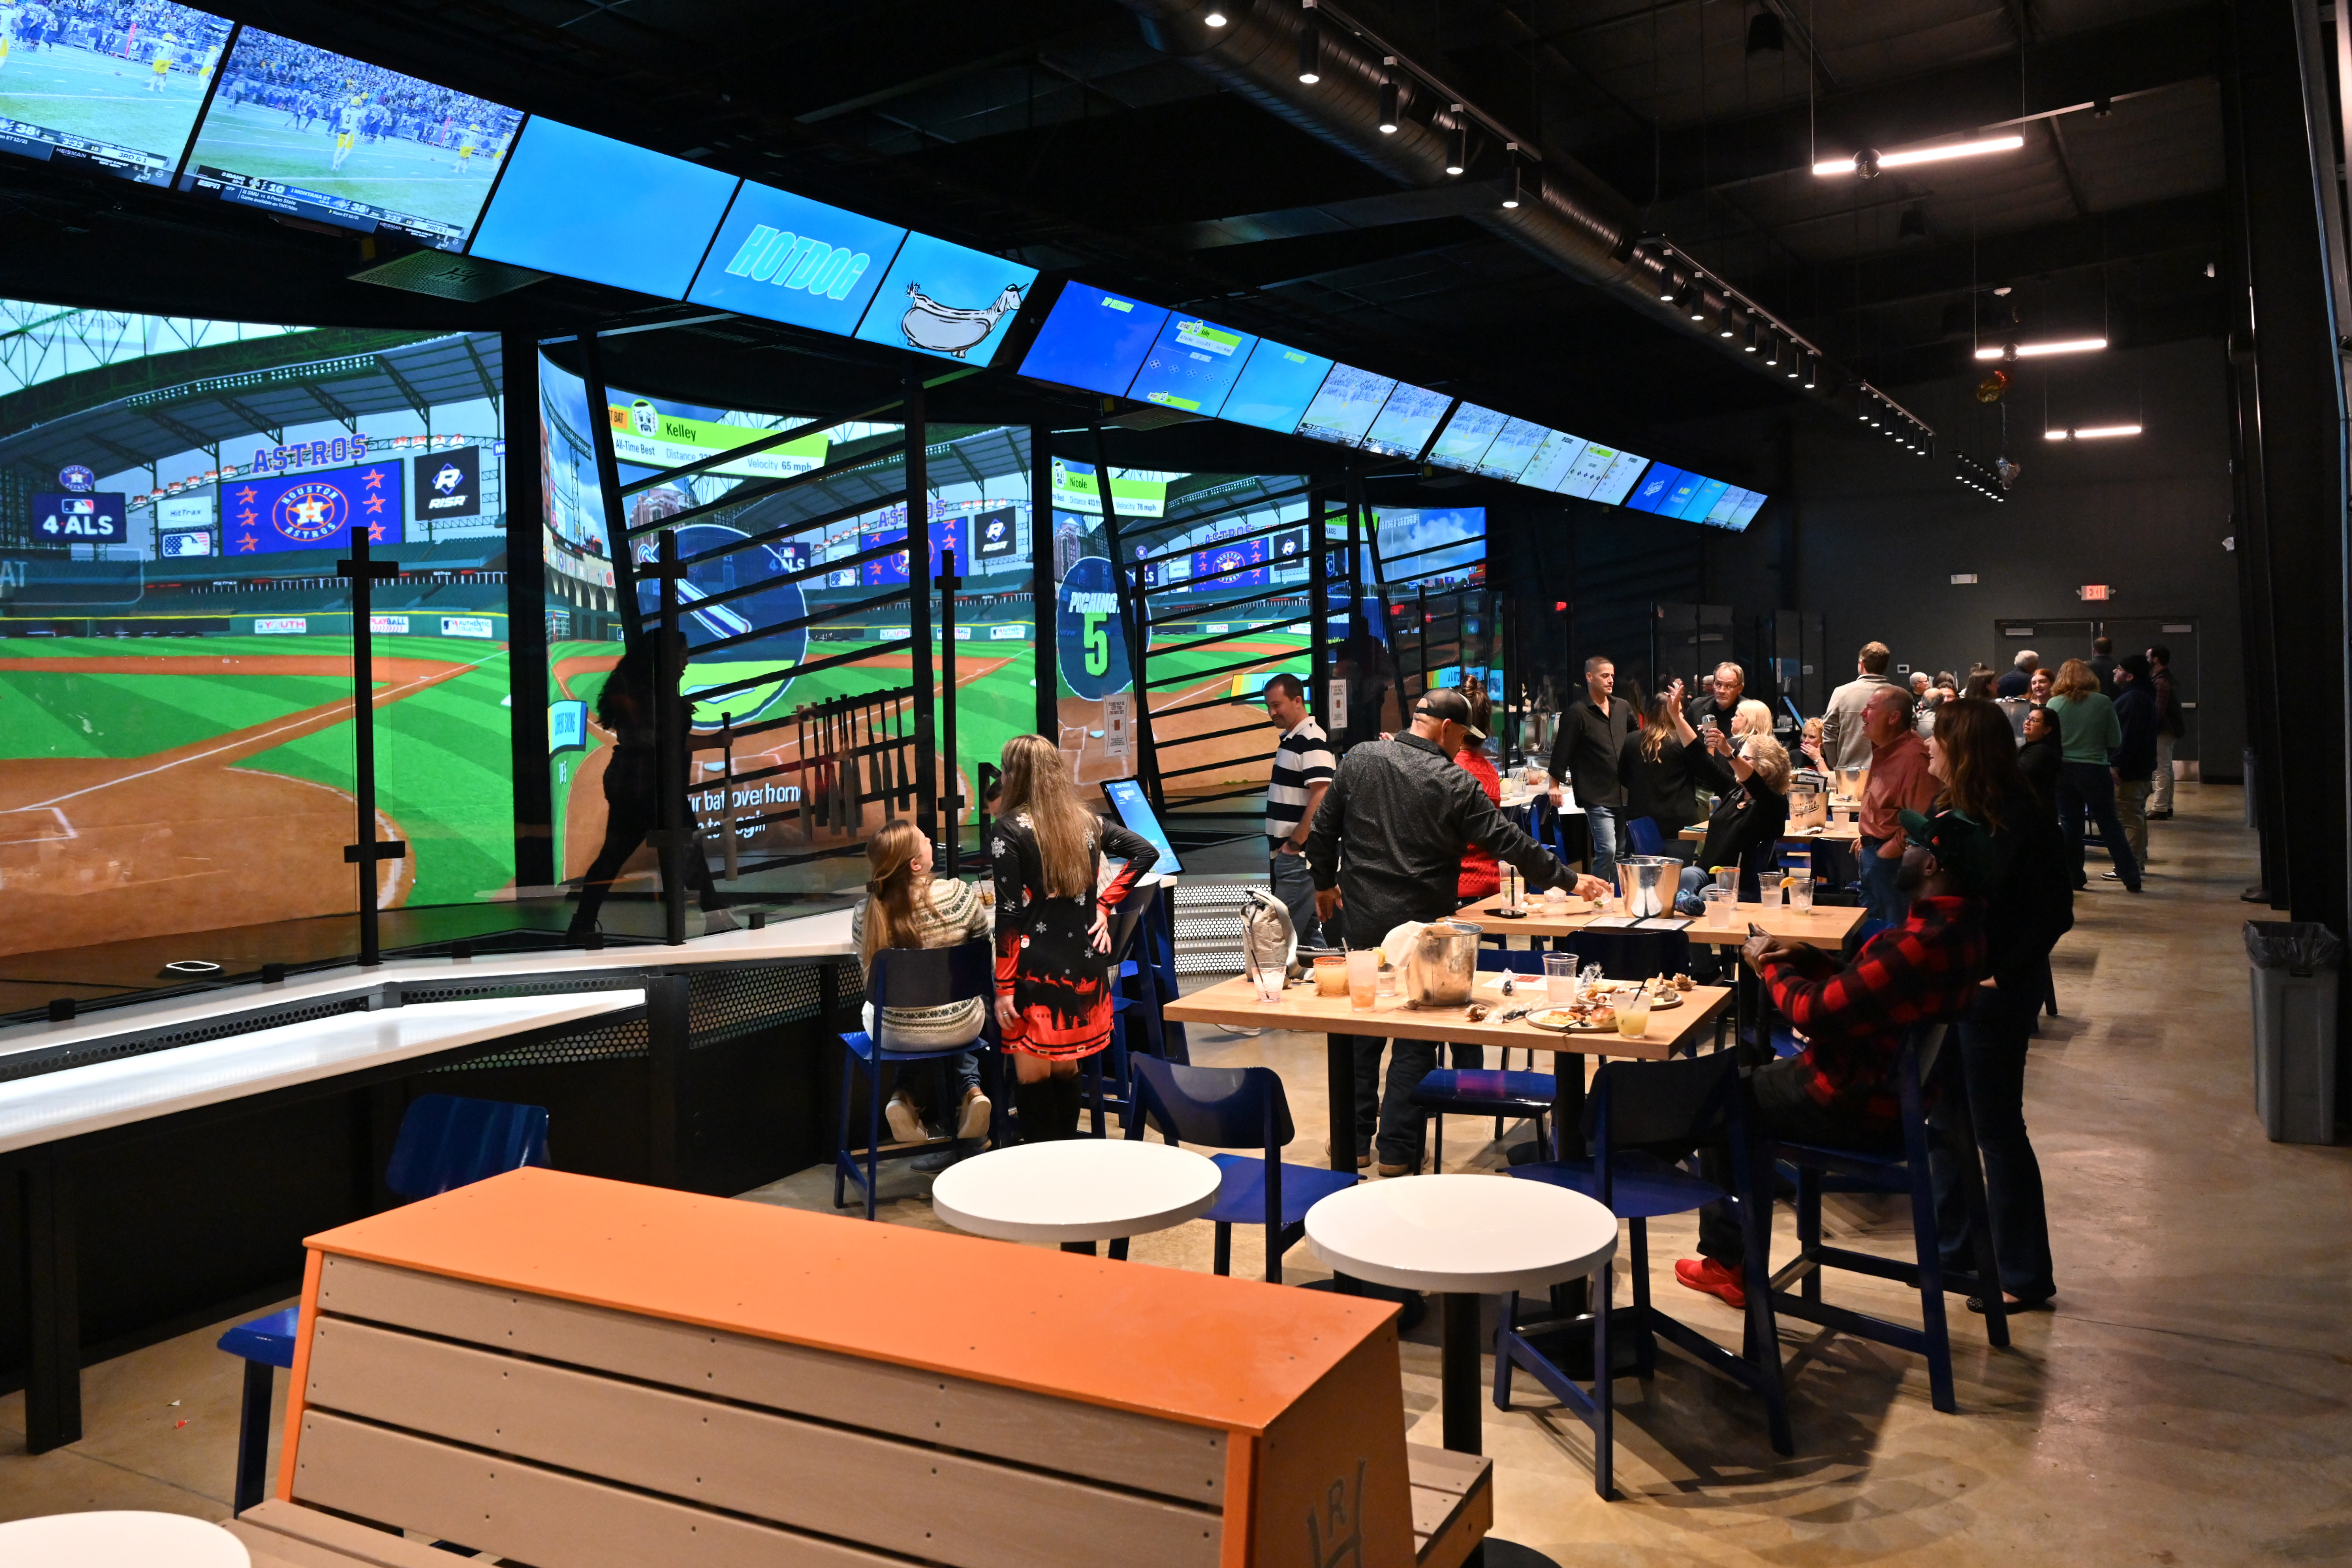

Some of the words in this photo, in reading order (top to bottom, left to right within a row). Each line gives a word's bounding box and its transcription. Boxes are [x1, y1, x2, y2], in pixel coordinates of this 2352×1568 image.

[16, 123, 36, 136] 38
[62, 138, 84, 148] 3:33
[55, 147, 87, 159] HEISMAN
[118, 152, 134, 161] 3RD
[226, 173, 246, 182] IDAHO
[196, 180, 221, 190] ESPN
[268, 184, 285, 195] 10
[253, 196, 272, 206] available
[294, 189, 322, 200] MONTANA
[351, 203, 366, 213] 38
[724, 223, 870, 301] HOTDOG
[67, 313, 87, 327] 62
[89, 317, 125, 332] mph
[614, 411, 624, 424] BAT
[666, 423, 697, 442] Kelley
[251, 433, 368, 474] ASTROS
[616, 439, 639, 454] All-Time
[640, 444, 655, 456] Best
[666, 448, 697, 462] Distance
[747, 458, 778, 471] Velocity
[781, 461, 792, 471] 65
[793, 462, 812, 472] mph
[1070, 477, 1088, 490] Nicole
[281, 485, 339, 505] HOUSTON
[1069, 496, 1087, 505] Distance
[1096, 499, 1101, 508] ft
[1116, 501, 1135, 511] Velocity
[169, 509, 202, 518] HitTrax
[42, 514, 59, 535] 4
[64, 514, 114, 535] ALS
[284, 522, 336, 539] ASTROS
[2086, 585, 2107, 599] EXIT
[458, 620, 490, 629] AUTHENTIC
[1084, 611, 1108, 676] 5
[732, 788, 764, 808] over
